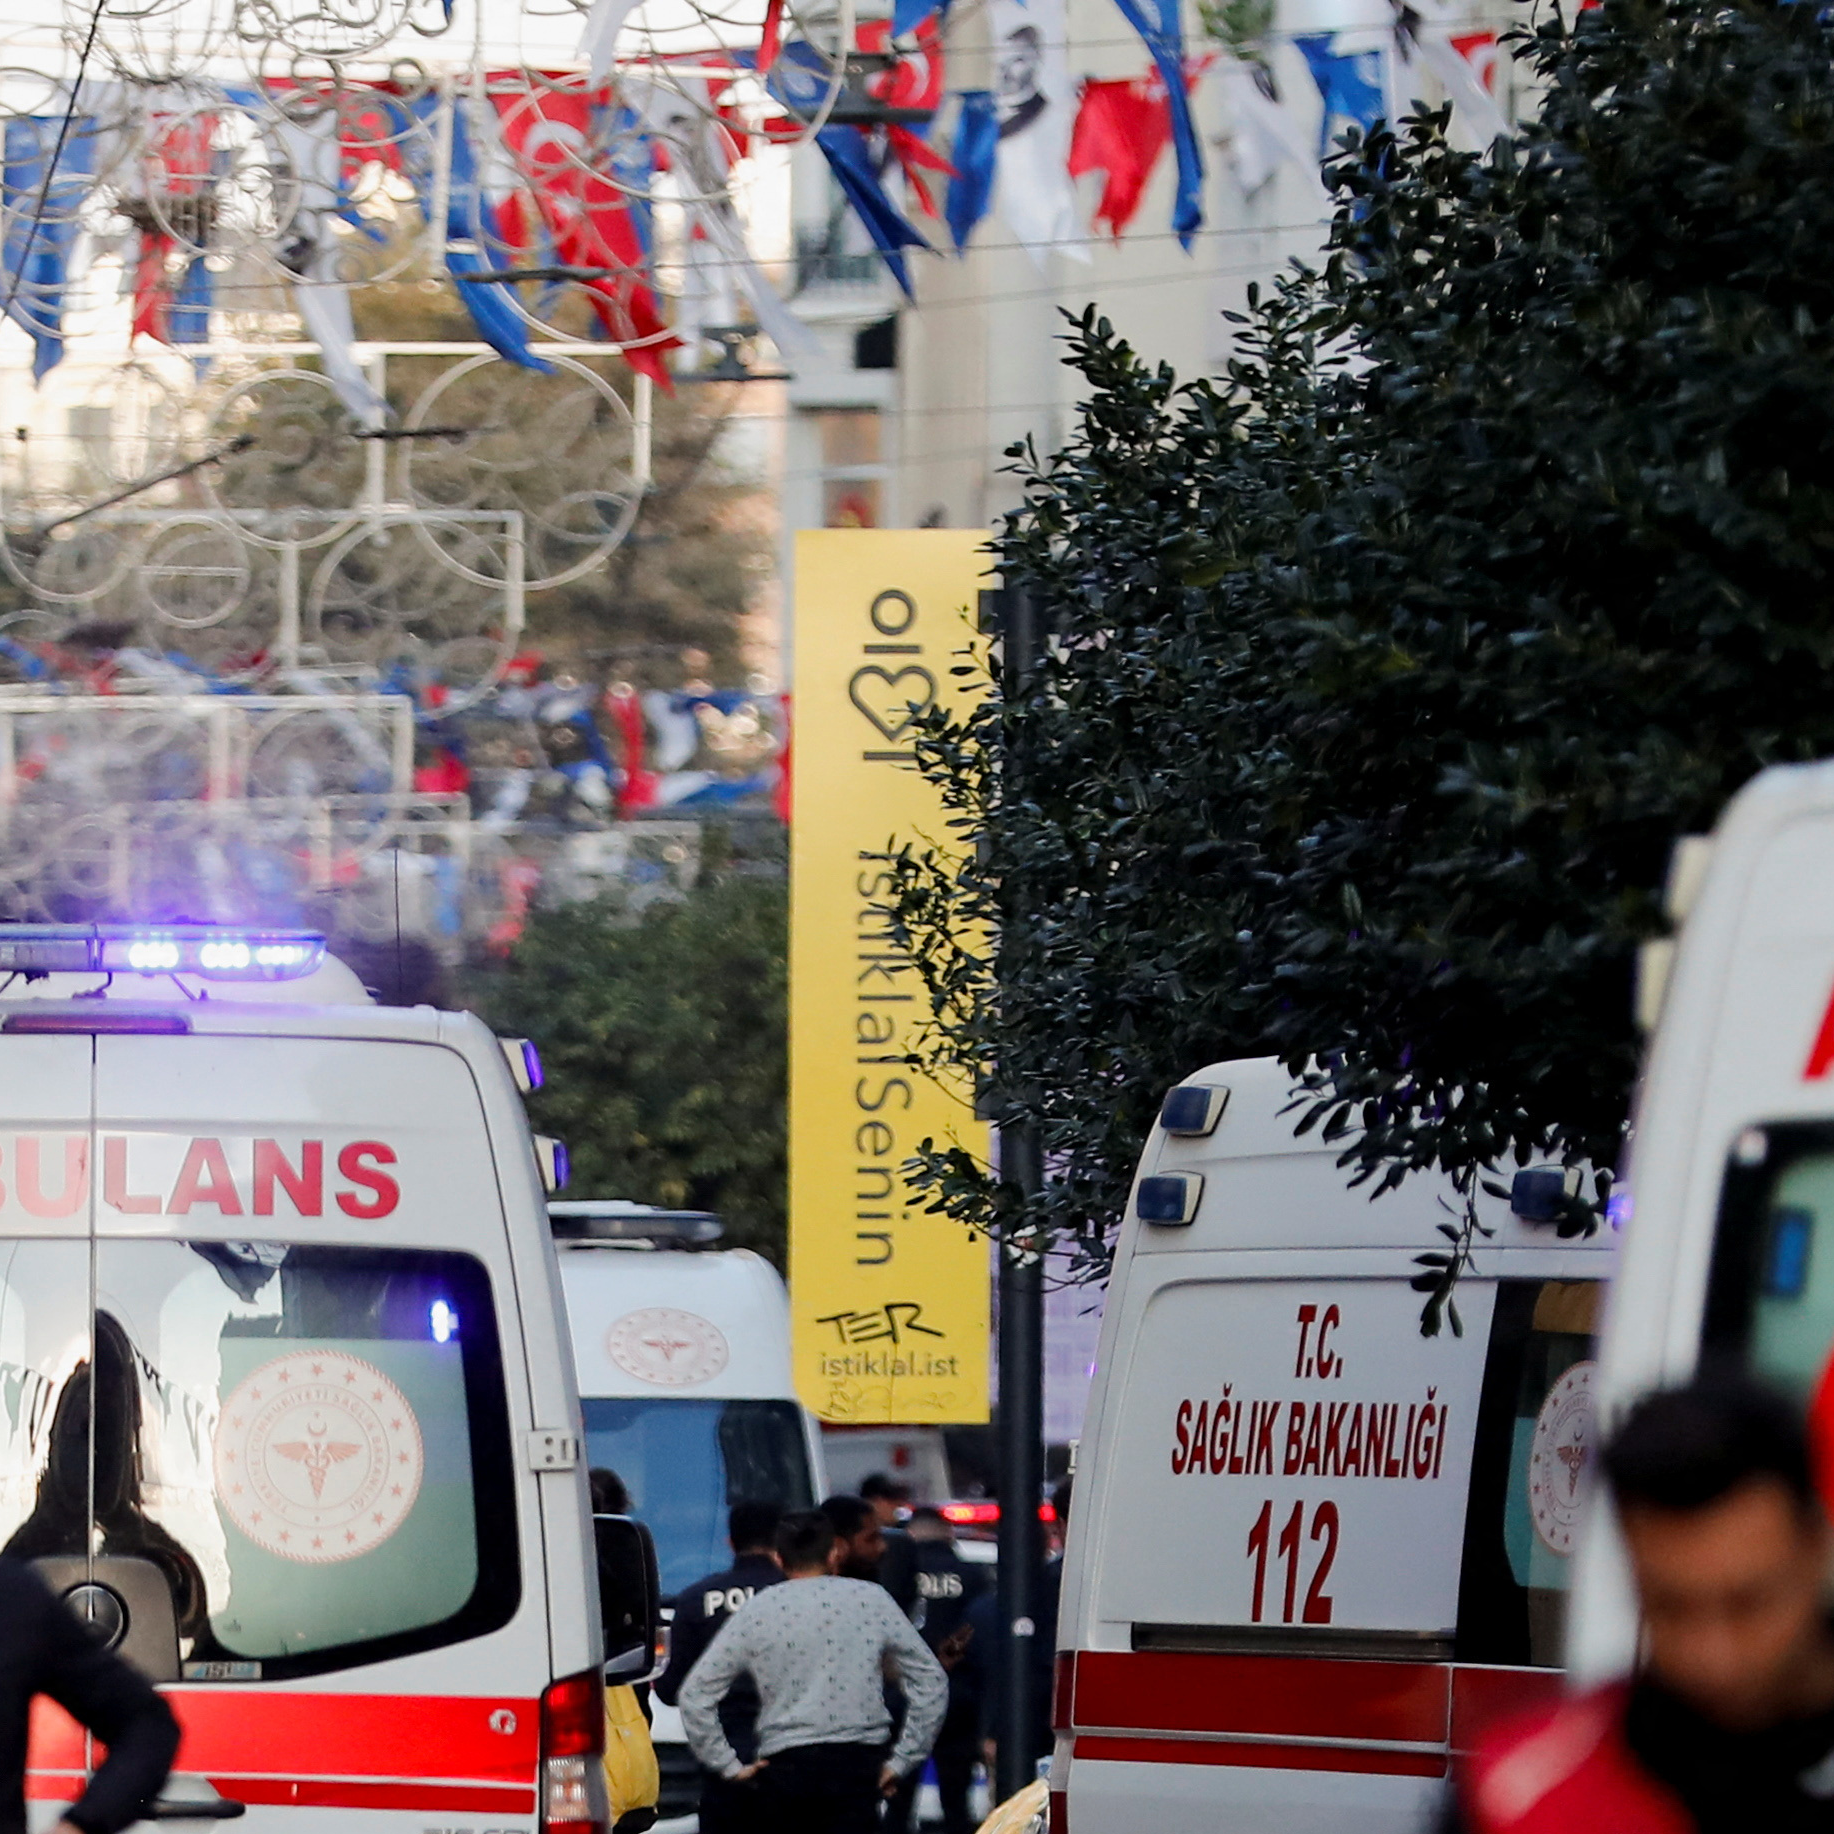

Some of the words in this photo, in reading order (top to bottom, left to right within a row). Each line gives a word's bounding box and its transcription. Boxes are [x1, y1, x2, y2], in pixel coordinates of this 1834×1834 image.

[821, 1350, 959, 1377] istiklal.ist
[1295, 1302, 1344, 1380] T.C.
[1171, 1382, 1282, 1476] SAĞLIK
[1282, 1384, 1449, 1480] BAKANLIĞI
[1247, 1499, 1340, 1624] 112
